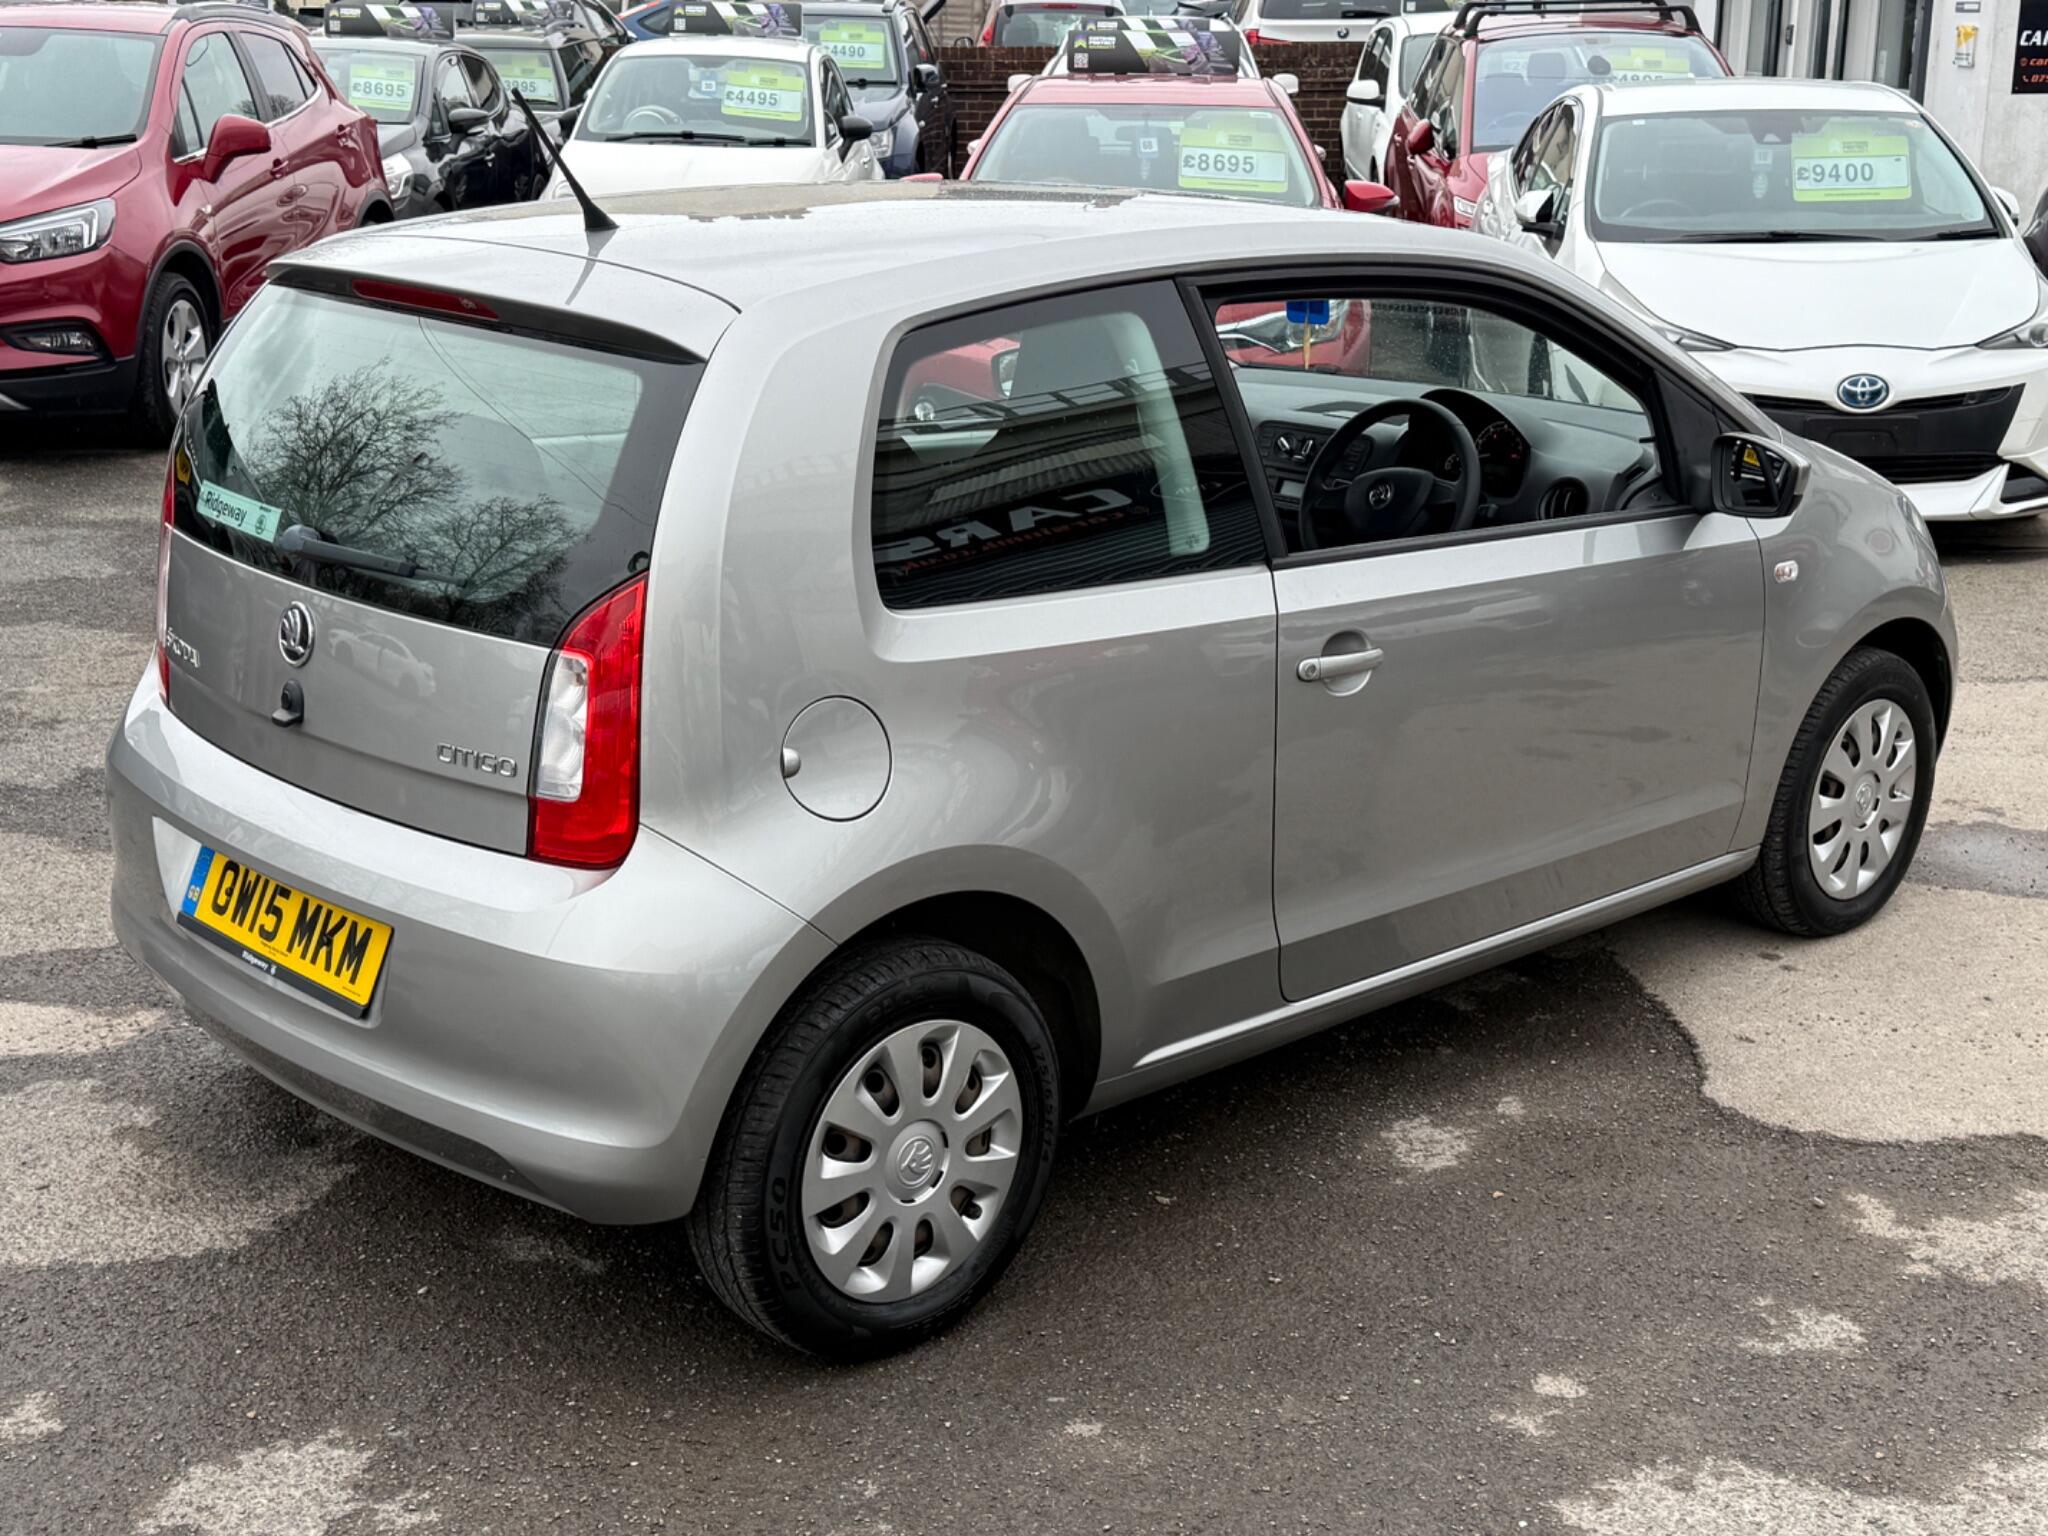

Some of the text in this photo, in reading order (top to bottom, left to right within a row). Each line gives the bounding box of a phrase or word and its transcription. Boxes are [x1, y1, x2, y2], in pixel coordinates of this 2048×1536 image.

[352, 81, 406, 97] £8695
[725, 89, 778, 106] £4495
[1182, 153, 1255, 174] £8695
[1796, 162, 1874, 183] £9400
[204, 490, 248, 527] Ridgeway
[437, 742, 517, 778] CITIGO
[286, 897, 373, 986] MKM
